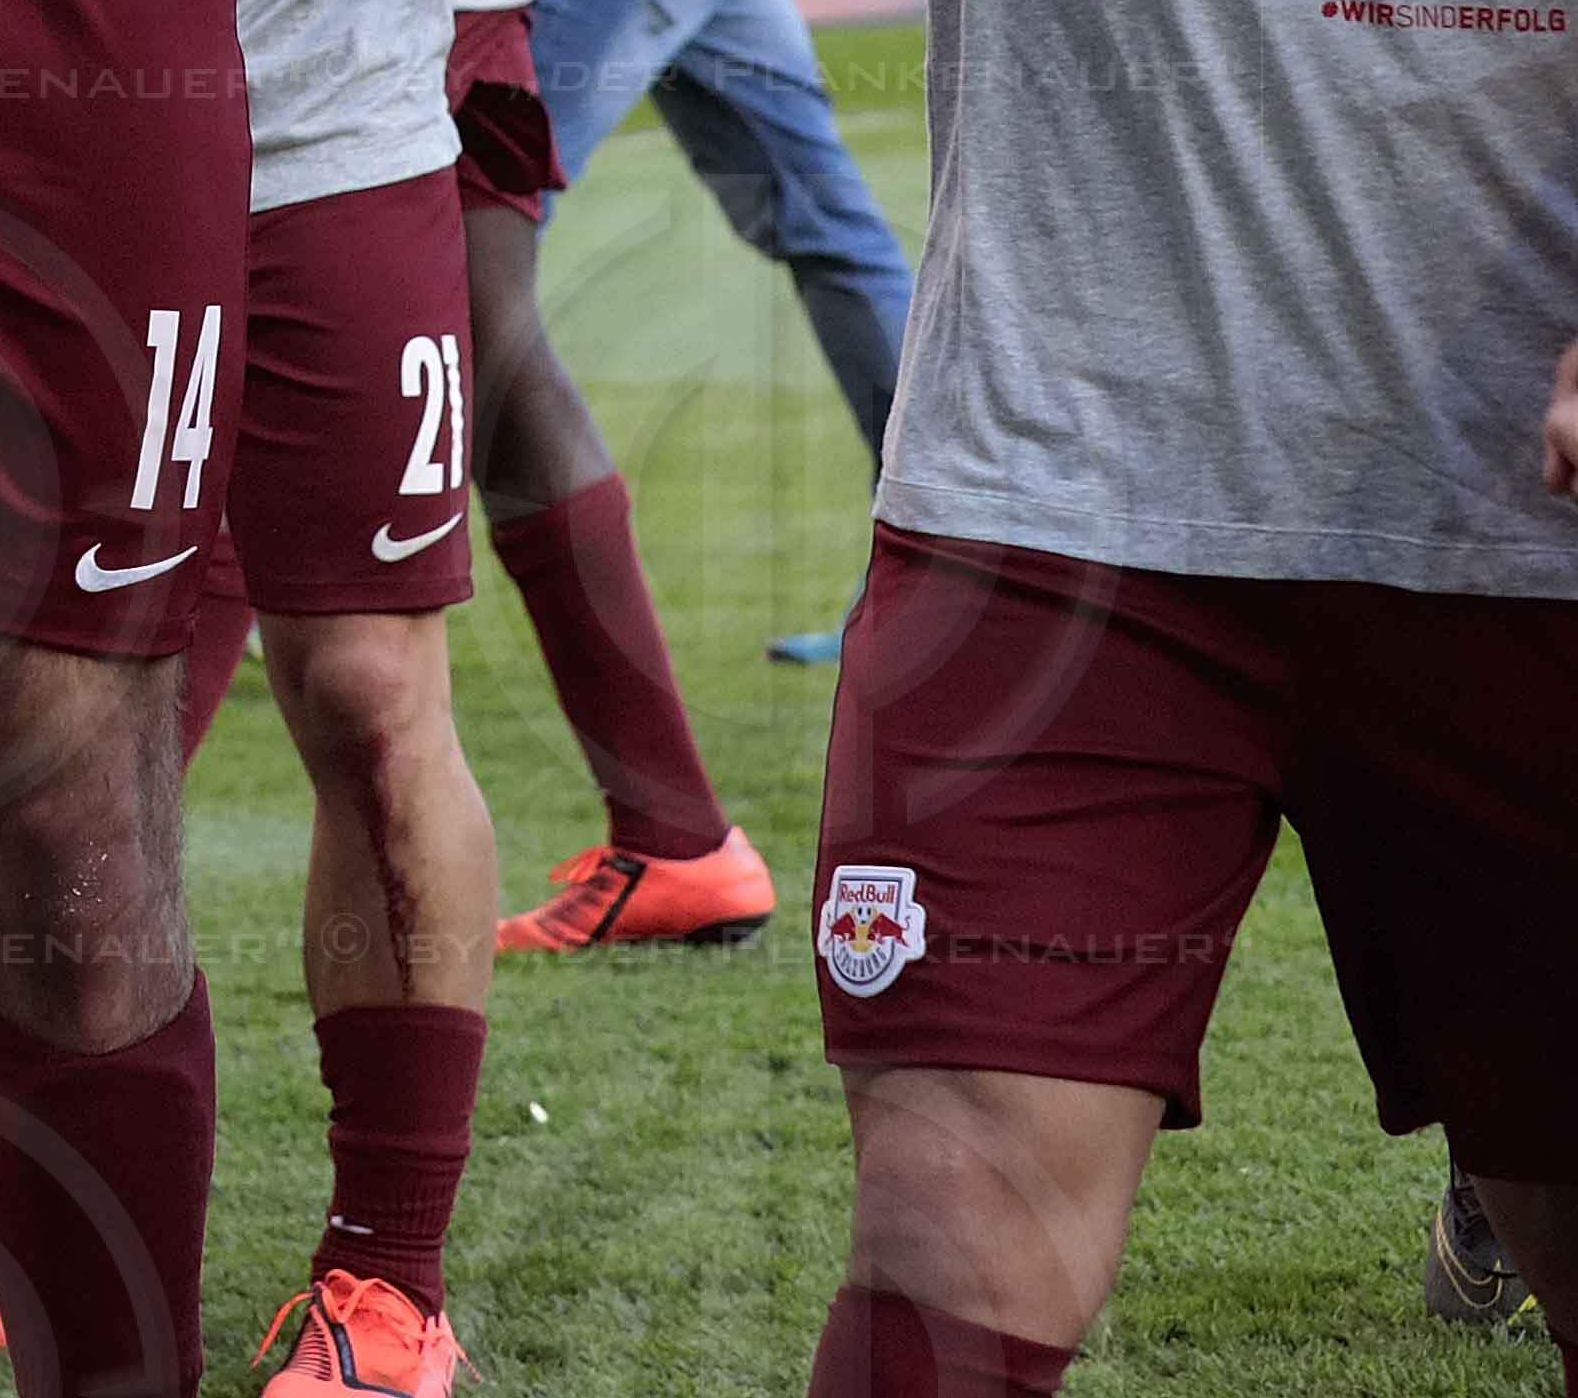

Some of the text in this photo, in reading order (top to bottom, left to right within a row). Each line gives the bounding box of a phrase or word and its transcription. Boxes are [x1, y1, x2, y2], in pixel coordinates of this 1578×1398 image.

[1321, 0, 1567, 33] #WIRSINDERFOLG
[130, 305, 222, 510] 14
[397, 335, 465, 496] 21
